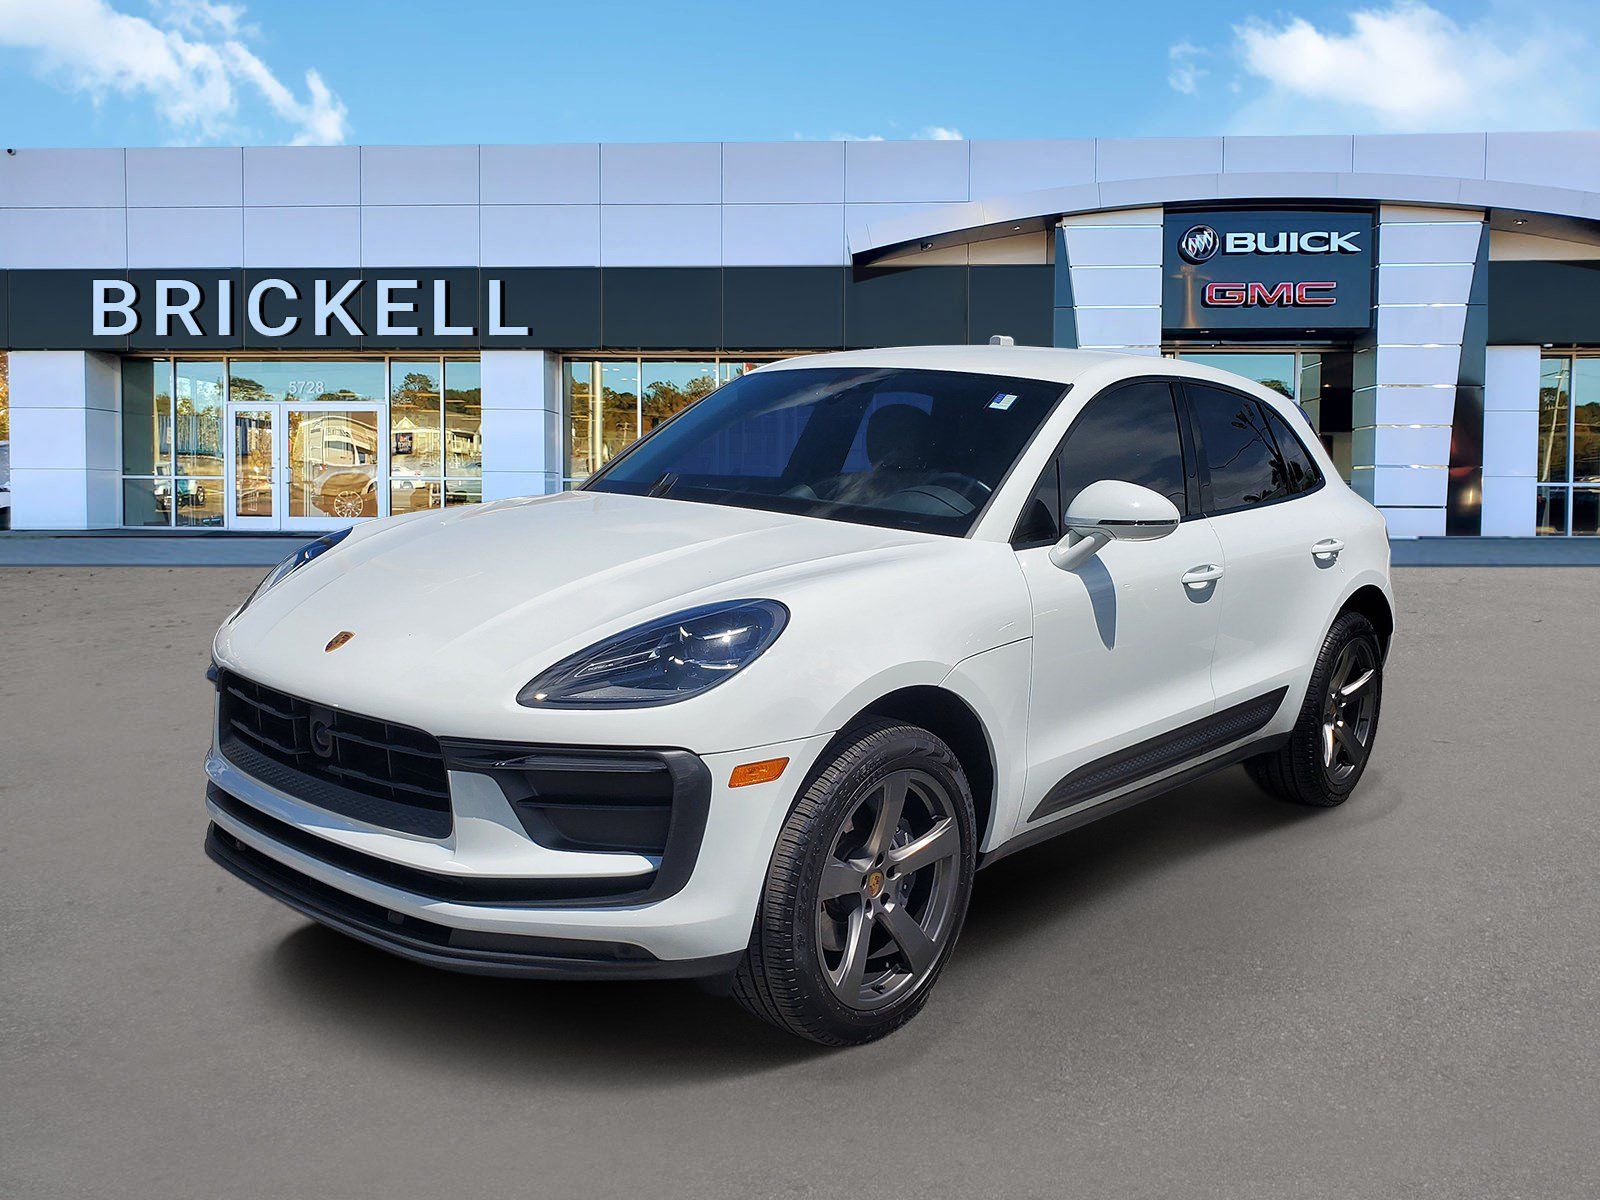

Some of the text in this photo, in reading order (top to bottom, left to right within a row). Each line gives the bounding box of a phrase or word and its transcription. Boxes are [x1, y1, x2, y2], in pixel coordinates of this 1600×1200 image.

[1225, 231, 1361, 252] BUICK
[1206, 281, 1337, 305] GMC
[92, 278, 530, 336] BRICKELL
[288, 380, 325, 395] 5728
